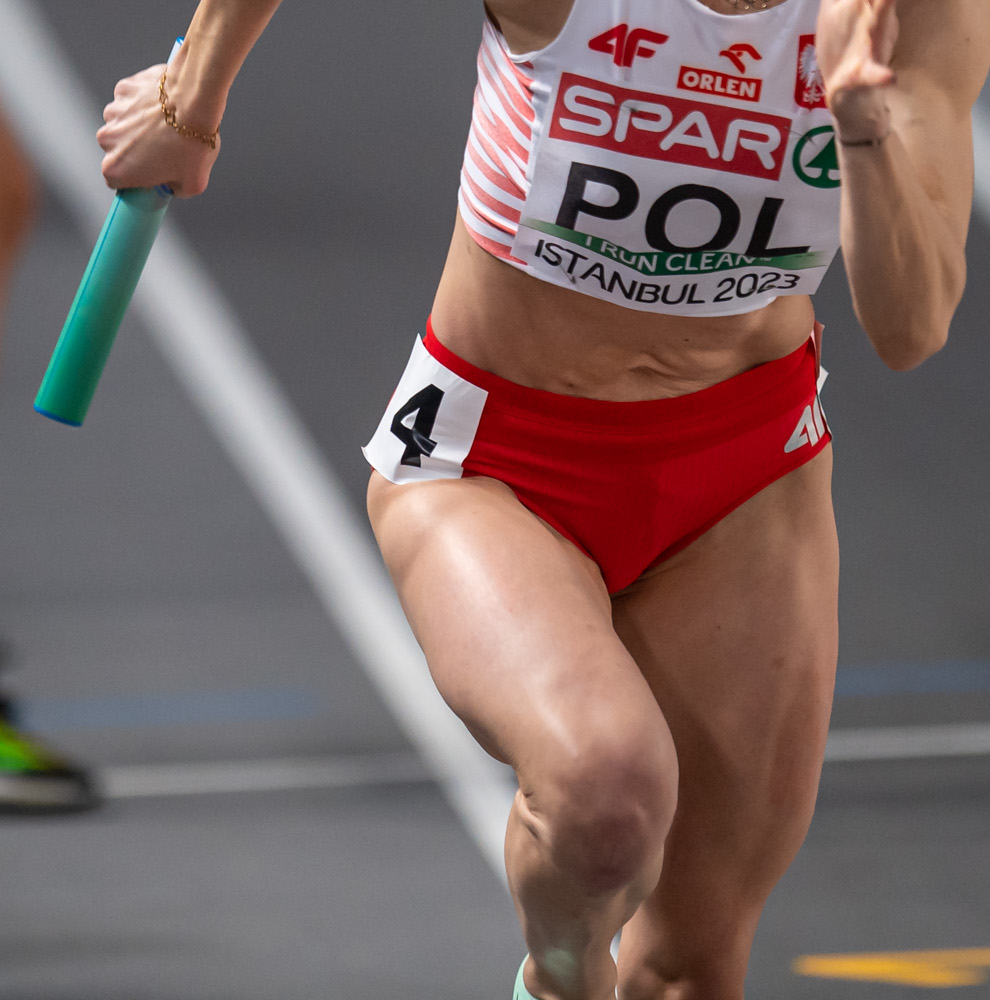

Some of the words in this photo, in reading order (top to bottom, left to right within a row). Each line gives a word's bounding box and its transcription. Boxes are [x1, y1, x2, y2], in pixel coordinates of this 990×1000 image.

[588, 22, 670, 68] 4F
[682, 71, 757, 98] ORLEN
[559, 84, 781, 170] SPAR
[555, 161, 811, 258] POL
[534, 239, 705, 305] ISTANBUL
[713, 272, 800, 303] 2023
[585, 236, 593, 247] I
[601, 239, 657, 273] RUN
[390, 384, 445, 467] 4
